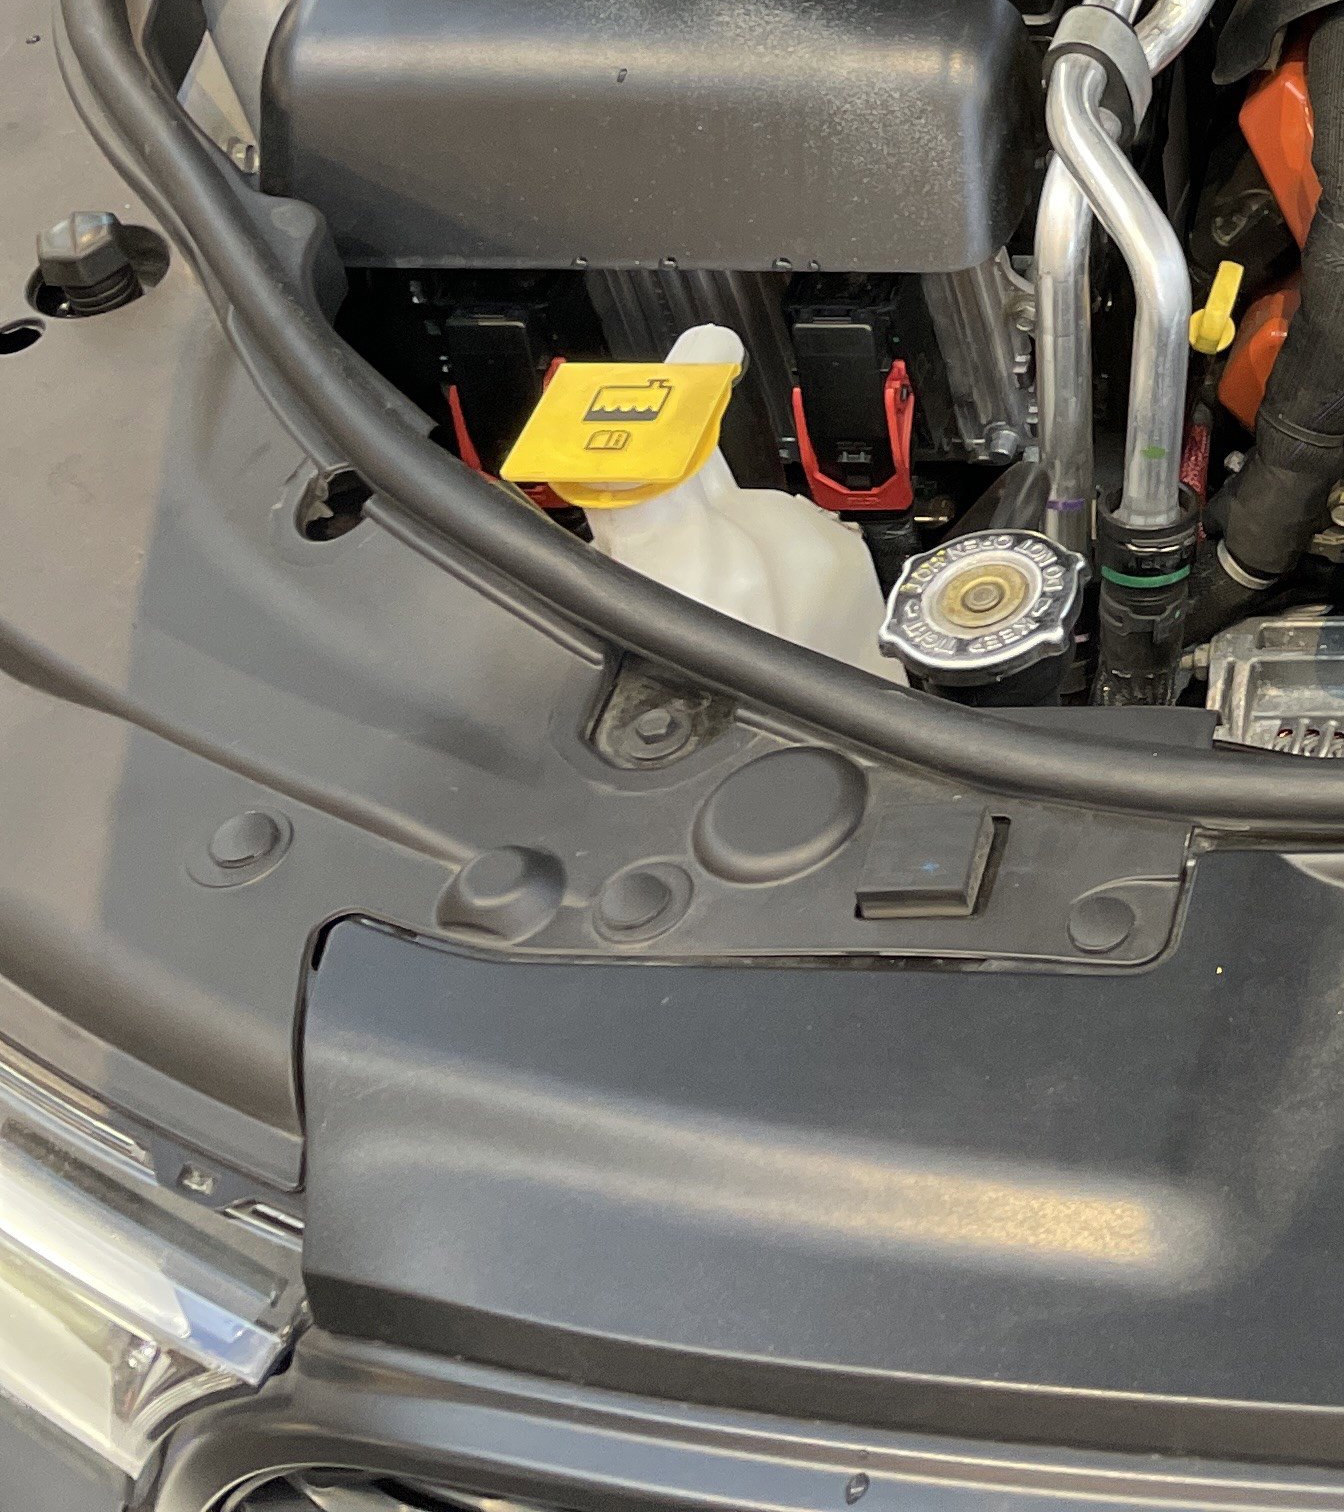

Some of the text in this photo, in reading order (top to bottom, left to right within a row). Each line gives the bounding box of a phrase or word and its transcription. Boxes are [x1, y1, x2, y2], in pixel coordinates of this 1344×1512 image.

[946, 534, 1014, 561] OPEN
[1014, 538, 1059, 568] NOT
[902, 617, 1040, 655] KEEP TIGHT
